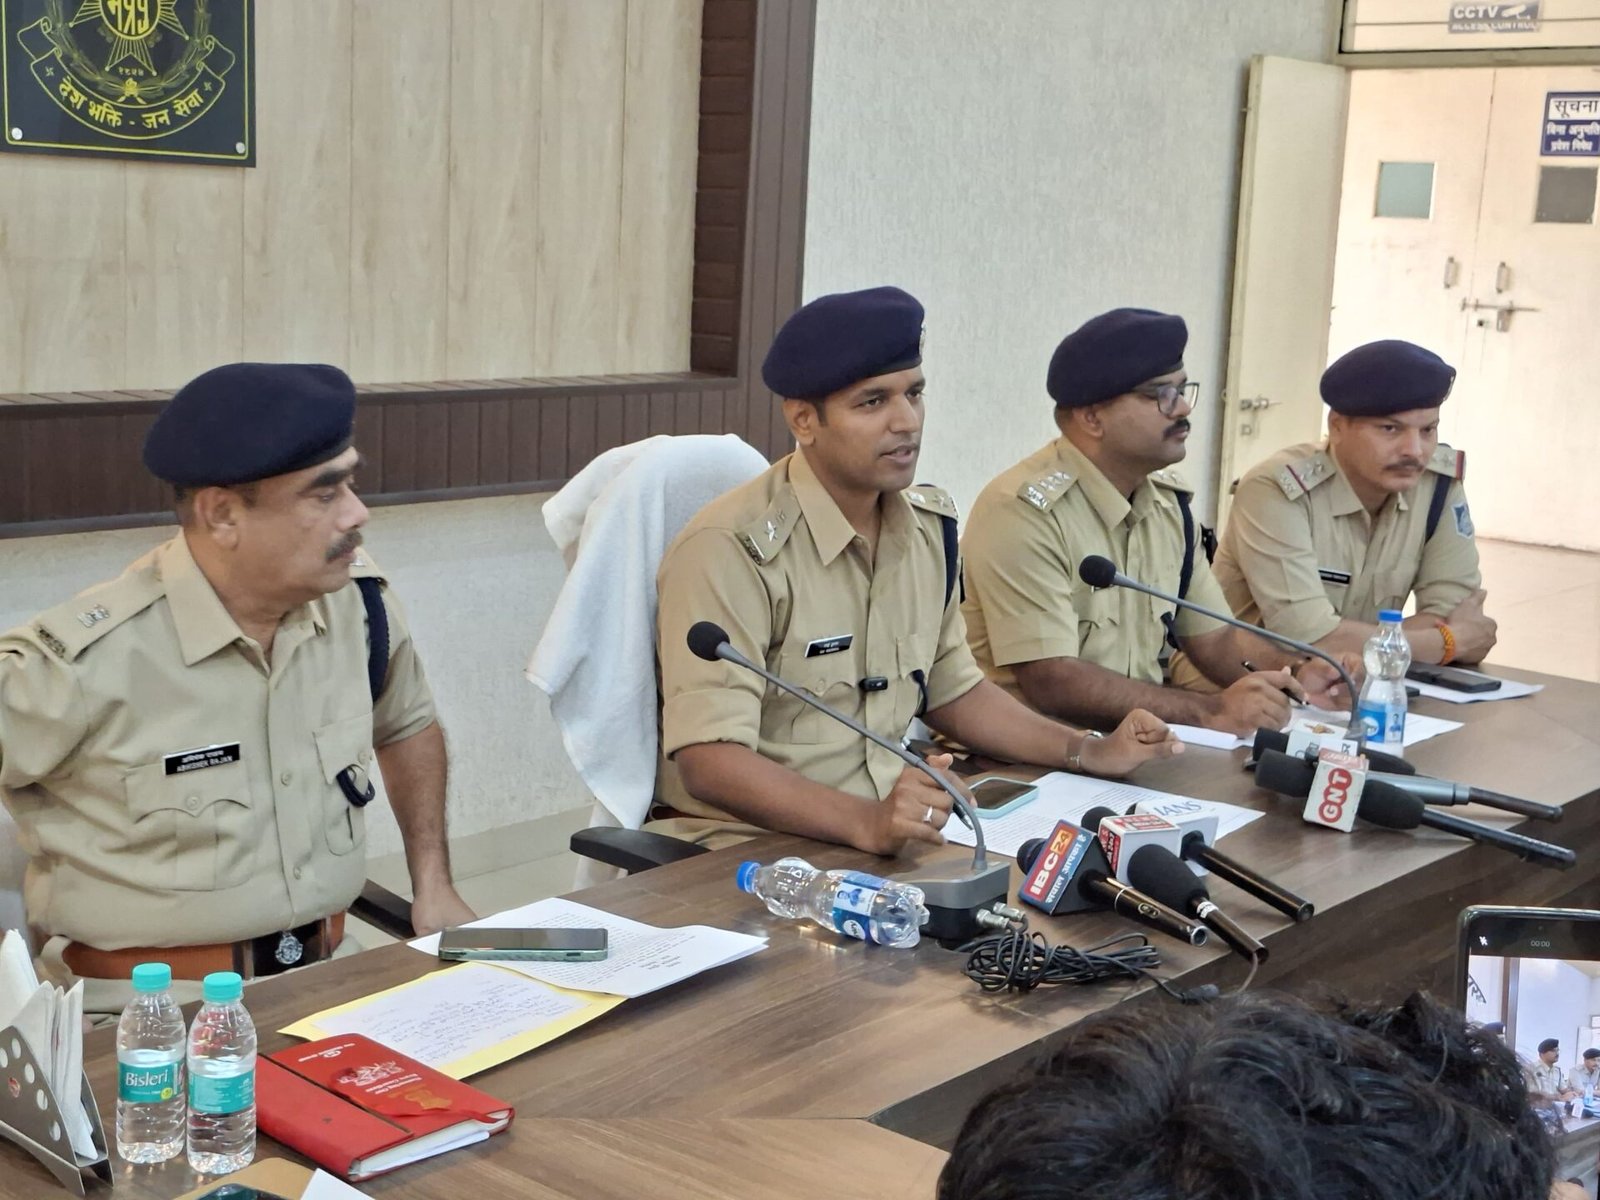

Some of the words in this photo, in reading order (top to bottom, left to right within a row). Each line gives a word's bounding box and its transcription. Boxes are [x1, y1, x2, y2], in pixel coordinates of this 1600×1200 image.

[1453, 5, 1499, 19] CCTV
[58, 75, 88, 111] देश
[88, 100, 123, 128] भक्ति
[141, 109, 171, 129] जन
[172, 89, 204, 117] सेवा
[1554, 100, 1600, 118] सूचना
[1321, 770, 1350, 820] GNT
[1154, 800, 1202, 816] IANS
[1045, 875, 1065, 904] सवाल
[1063, 843, 1083, 877] आपका
[1077, 832, 1087, 848] है
[125, 1069, 168, 1087] Bisleri
